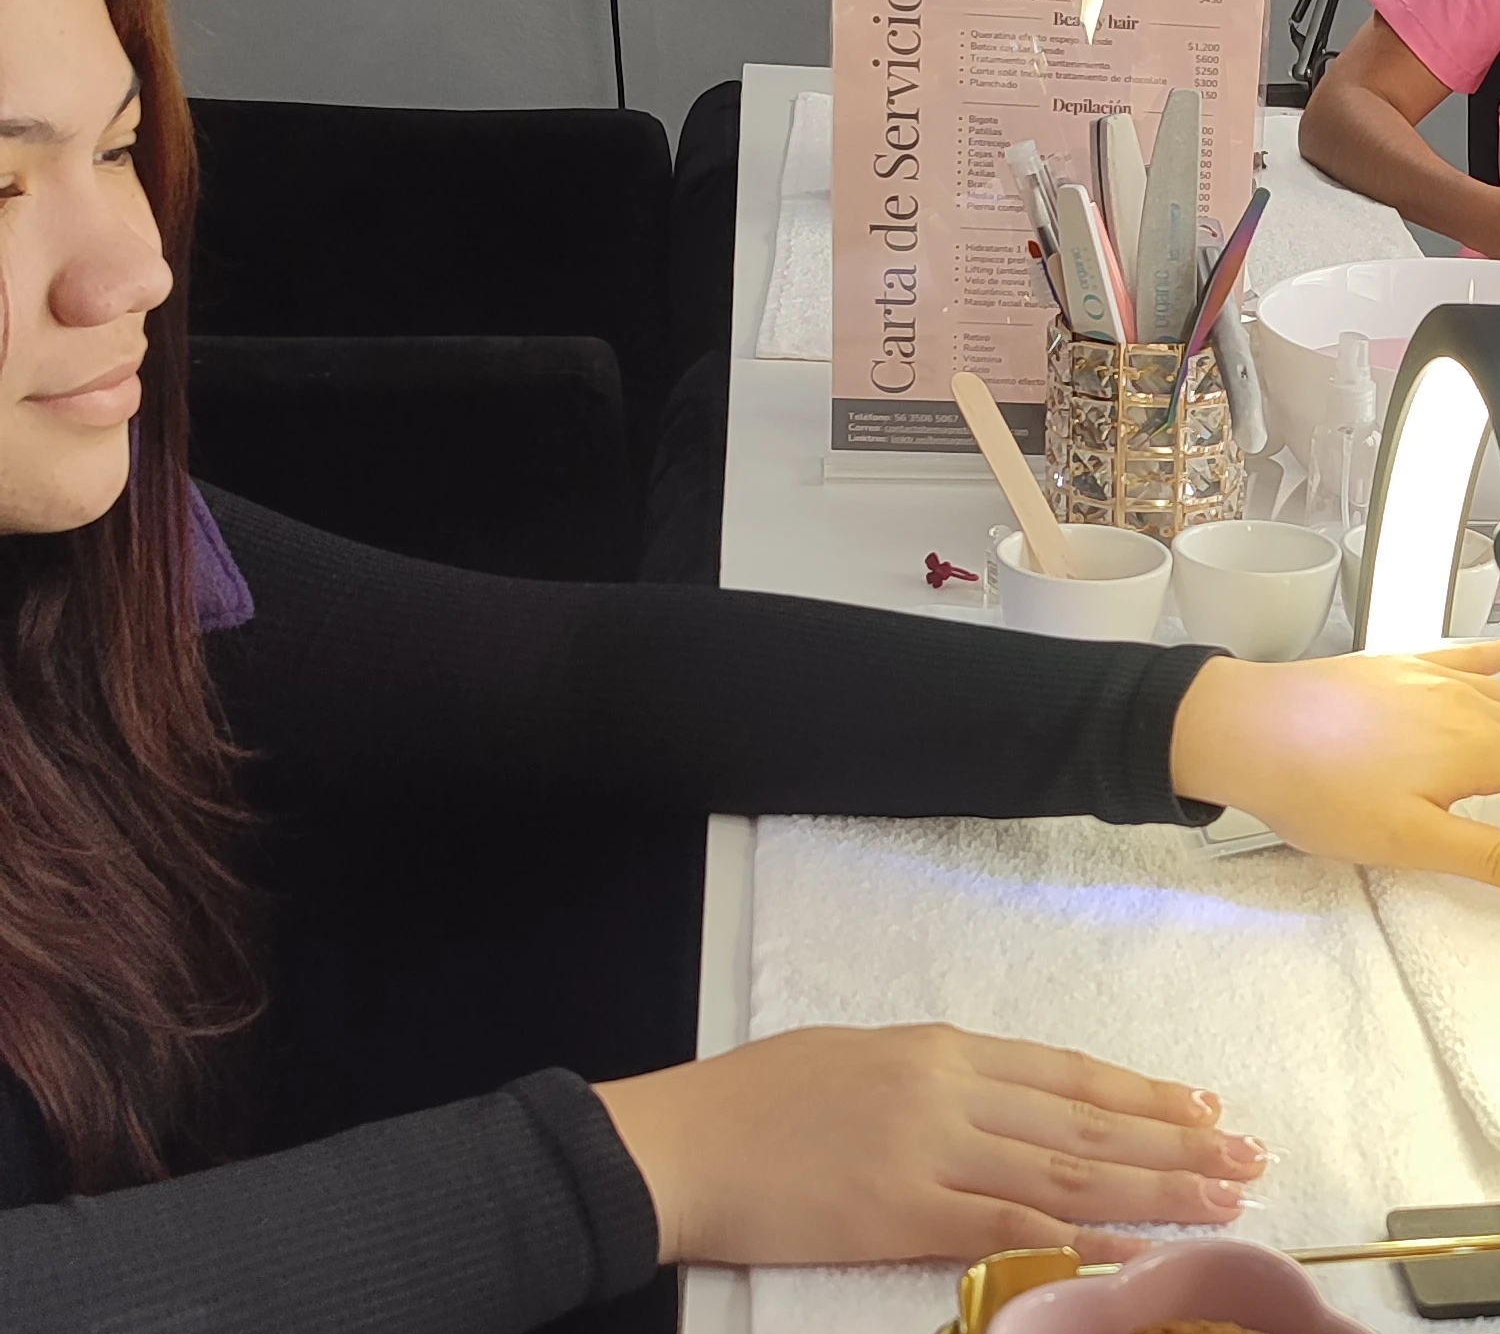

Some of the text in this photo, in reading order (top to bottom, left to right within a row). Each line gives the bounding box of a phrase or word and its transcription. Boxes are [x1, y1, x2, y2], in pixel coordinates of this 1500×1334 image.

[1053, 12, 1139, 31] Beay hair
[970, 29, 1017, 42] Queratina
[970, 42, 998, 52] Botox
[970, 54, 1027, 65] Tratamiento
[1196, 55, 1220, 65] $600
[970, 66, 995, 76] Corte
[1056, 72, 1109, 83] tratamiento
[1111, 74, 1122, 83] de
[1195, 67, 1219, 77] $250
[970, 78, 1018, 89] Planchado
[1194, 78, 1218, 88] $300
[1201, 91, 1217, 100] 150
[1053, 97, 1132, 116] Depilación
[968, 115, 998, 126] Bigote
[968, 126, 1003, 136] Patillas
[968, 137, 1011, 149] Entrecejo
[968, 158, 994, 168] Facial
[968, 169, 996, 178] Axilas
[967, 202, 1025, 214] Pierna compl
[869, 195, 919, 252] de
[965, 244, 1014, 253] Hidratante
[965, 254, 1005, 264] Limpieza
[965, 265, 994, 275] Lifting
[965, 277, 986, 285] Velo
[988, 277, 998, 286] de
[964, 298, 995, 308] Masaje
[998, 299, 1022, 308] facial
[870, 264, 917, 394] Carta
[963, 333, 991, 342] Retiro
[963, 343, 996, 353] Rubber
[963, 354, 1002, 364] Vitamina
[1018, 377, 1046, 386] efecto
